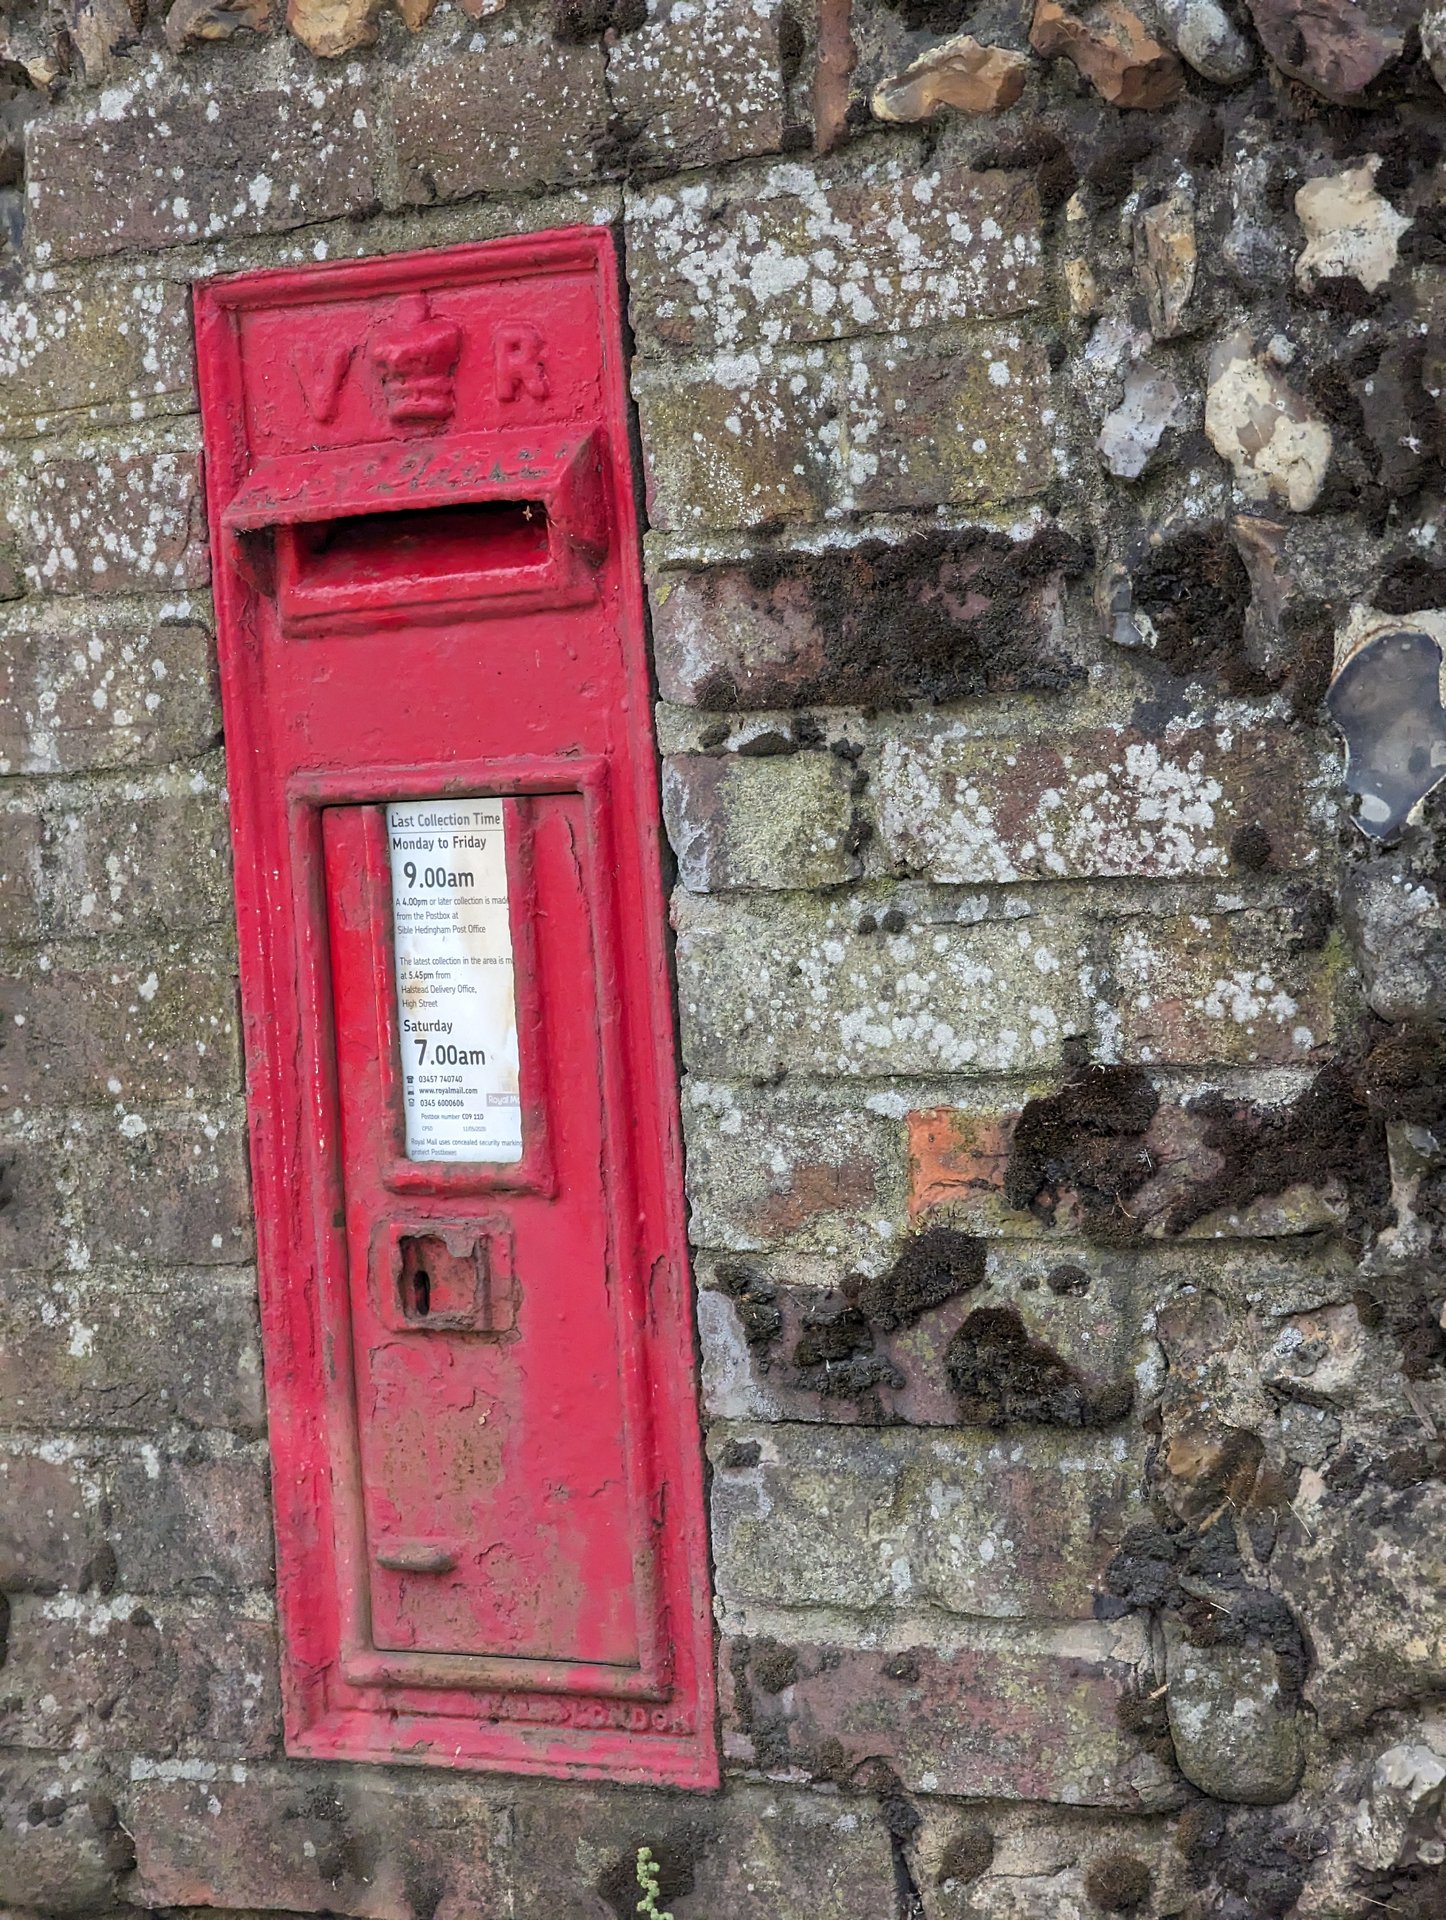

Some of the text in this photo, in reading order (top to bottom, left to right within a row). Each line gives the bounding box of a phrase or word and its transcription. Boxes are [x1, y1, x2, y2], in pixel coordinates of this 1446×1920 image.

[495, 321, 549, 402] R
[391, 812, 500, 828] Last Collection Time
[393, 835, 486, 852] Monday to Friday
[403, 861, 474, 889] 9.00am
[402, 897, 428, 907] 4.00pm
[438, 897, 452, 906] later
[454, 896, 485, 905] collection
[485, 896, 491, 905] is
[492, 896, 509, 905] mad
[397, 911, 459, 920] from the Postbox at
[398, 924, 486, 936] Sible Hedingham Post Office
[400, 957, 412, 965] The
[413, 956, 430, 965] latest
[432, 956, 461, 965] collection
[463, 956, 469, 965] in
[471, 956, 481, 965] the
[483, 957, 497, 965] area
[498, 956, 504, 965] is
[400, 971, 451, 981] at 5.45pm from
[401, 984, 477, 995] Halstead Delivery Office,
[402, 1000, 438, 1010] High Street
[403, 1019, 453, 1034] Saturday
[414, 1039, 486, 1066] 7.00am
[418, 1075, 463, 1083] 03457 740740
[419, 1087, 478, 1095] www.royalmail.com
[420, 1099, 464, 1107] 0345 6000606
[488, 1095, 509, 1105] Royal
[410, 1138, 425, 1146] Royal
[427, 1138, 437, 1146] Mail
[479, 1139, 500, 1147] security
